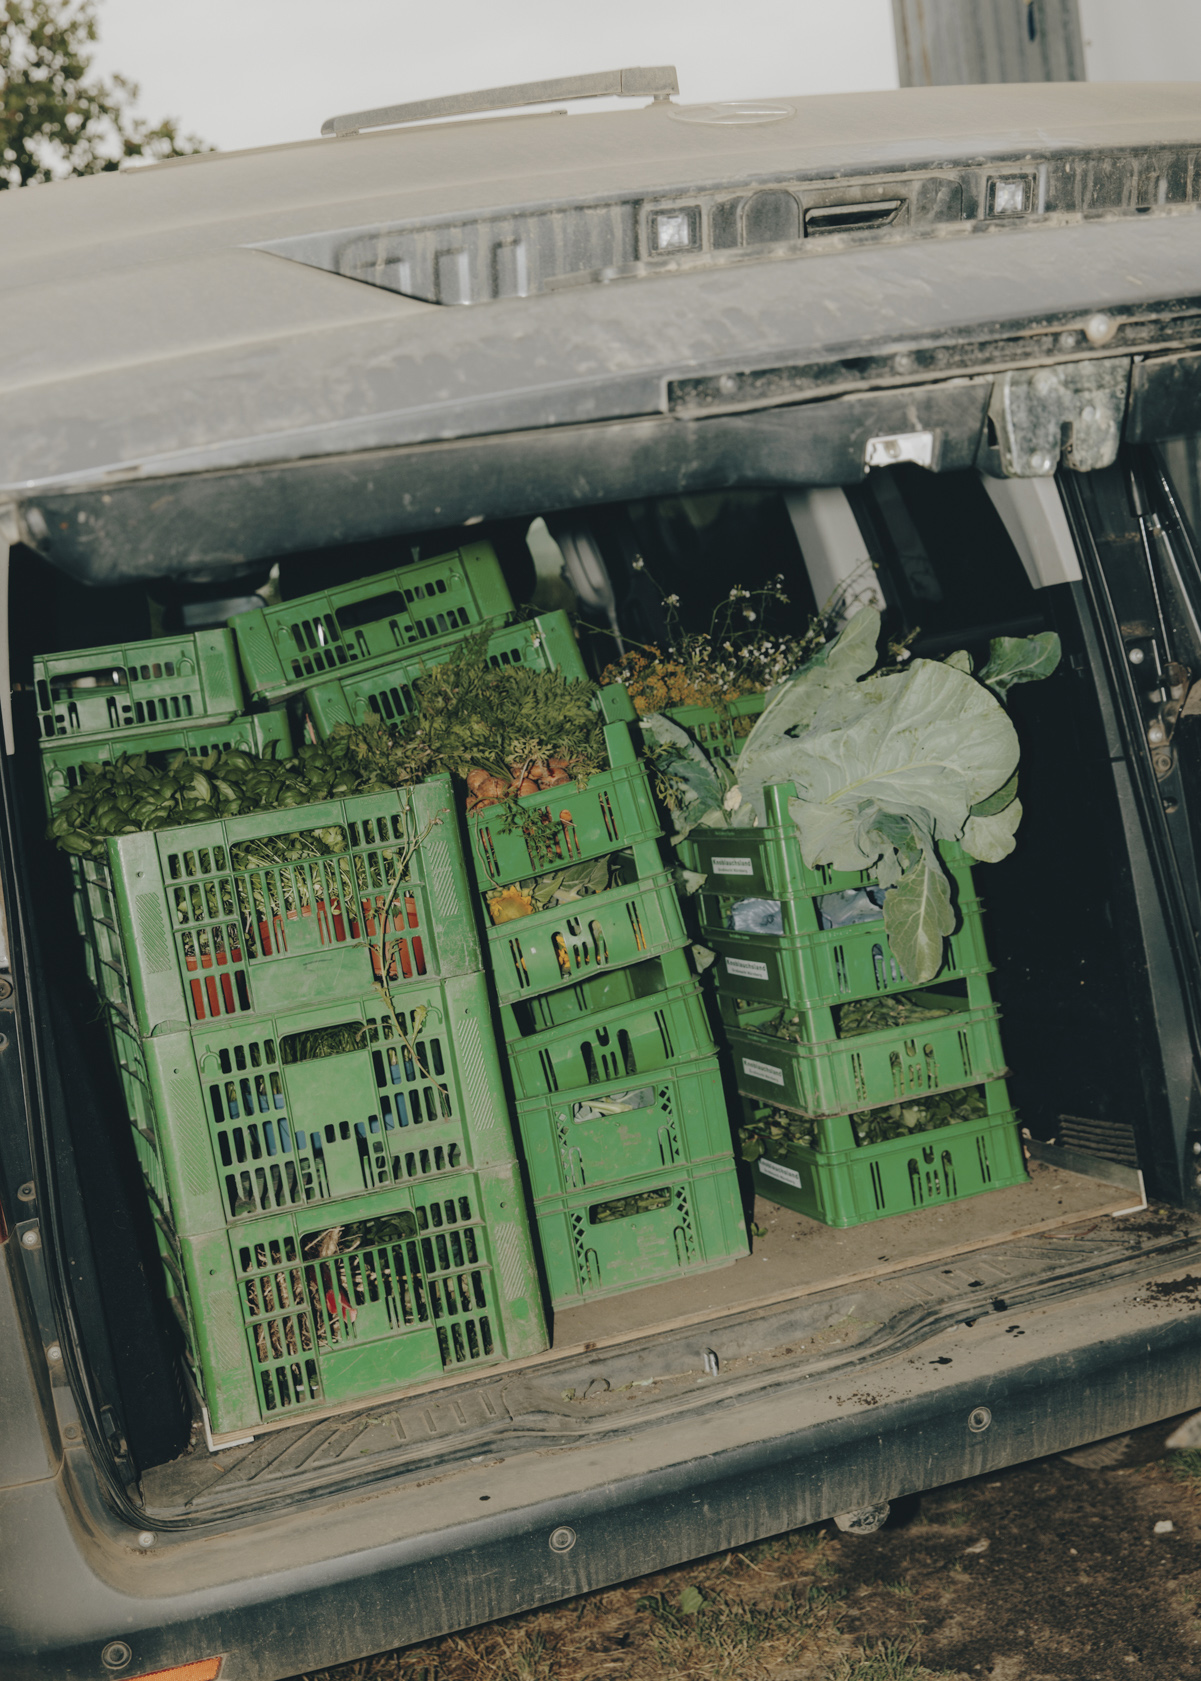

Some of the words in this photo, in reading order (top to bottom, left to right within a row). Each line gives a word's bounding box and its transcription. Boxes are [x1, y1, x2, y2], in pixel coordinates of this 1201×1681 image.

[713, 859, 751, 867] Knoblauchsland
[727, 959, 765, 971] Knoblauchsland
[744, 1060, 782, 1077] Knoblauchsland
